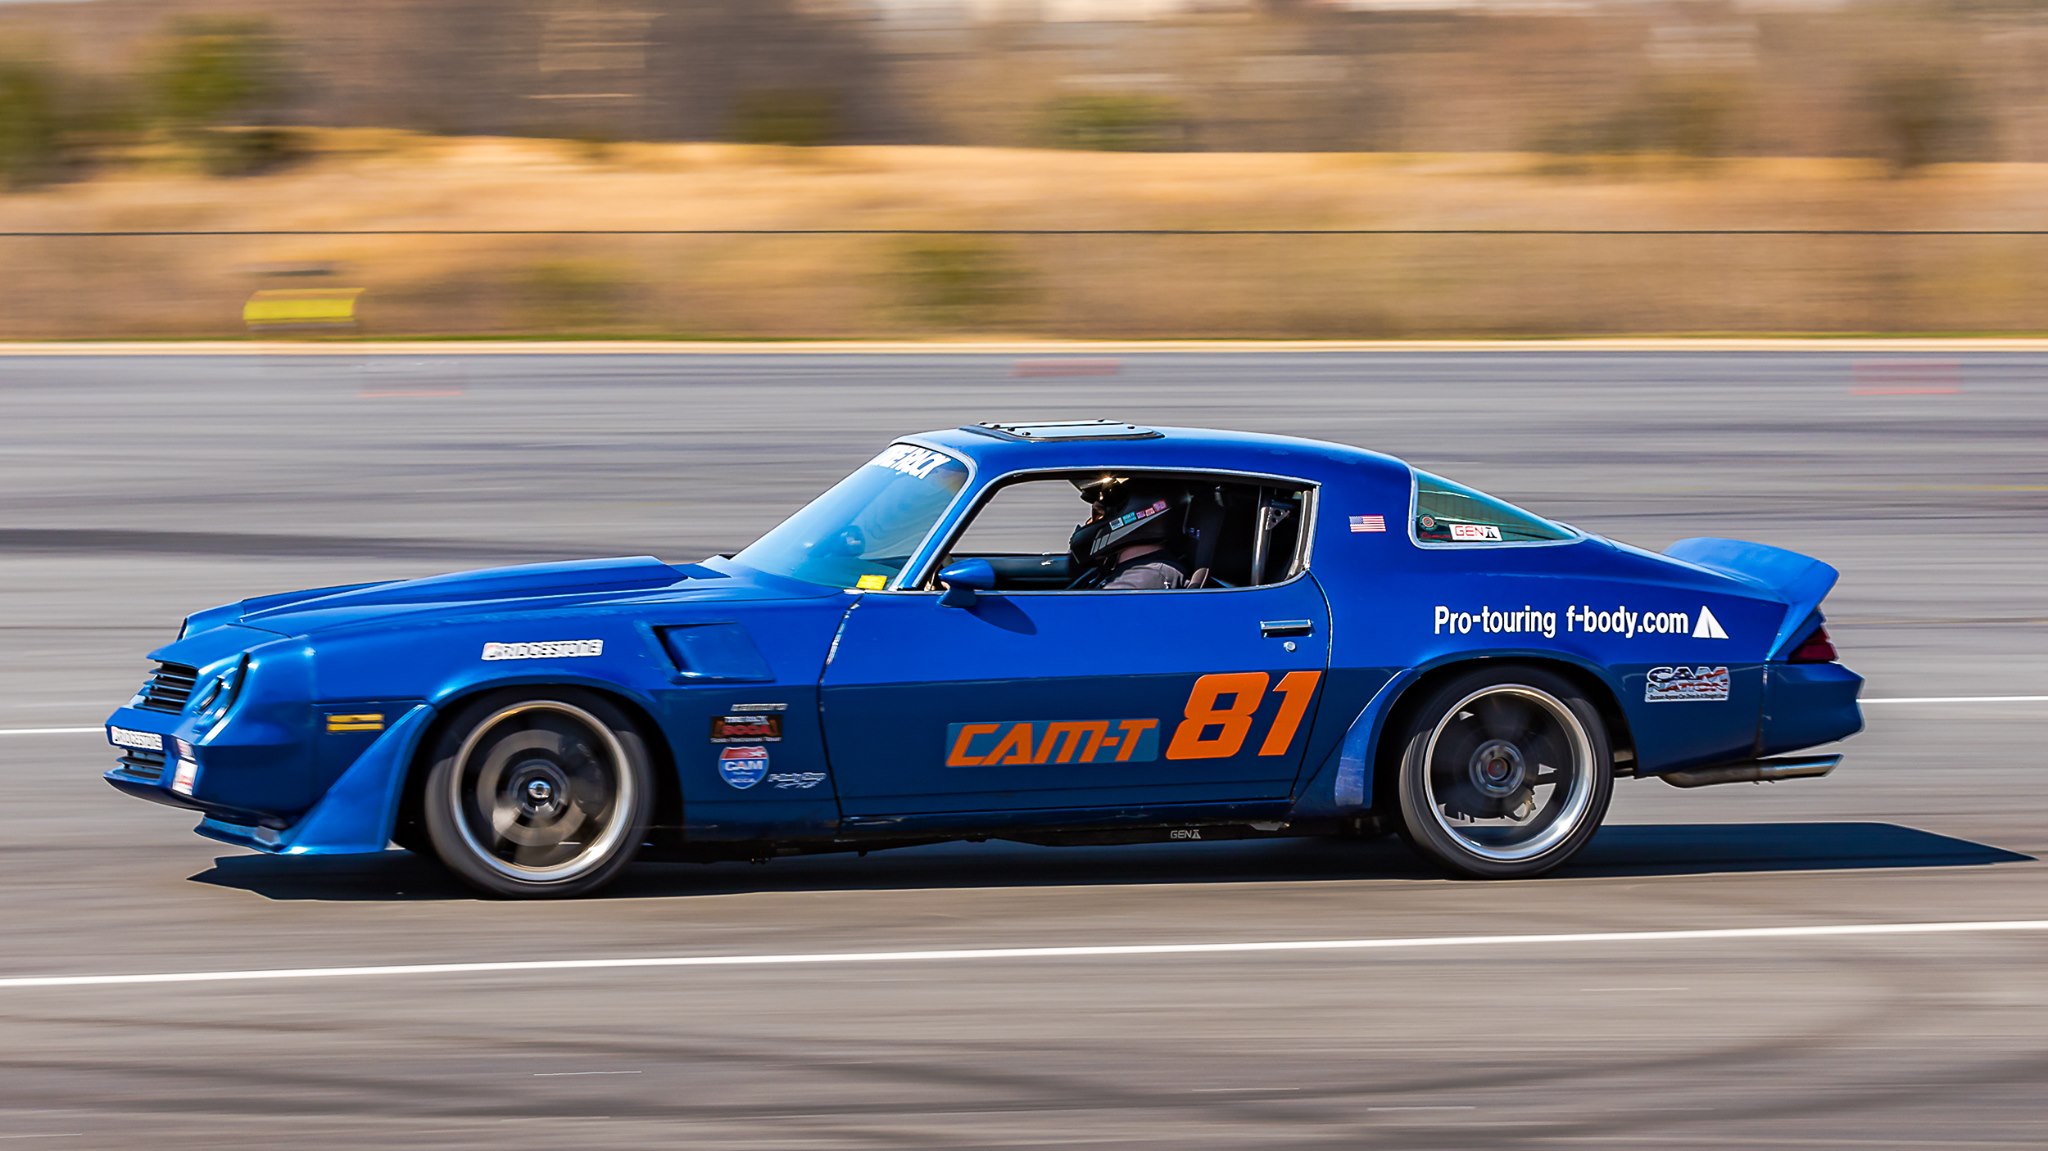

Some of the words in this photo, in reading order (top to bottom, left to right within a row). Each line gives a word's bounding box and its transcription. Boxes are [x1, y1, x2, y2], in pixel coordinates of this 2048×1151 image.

[1434, 605, 1556, 638] Pro-touring
[1566, 605, 1689, 638] f-body.com
[1647, 666, 1729, 684] CAM
[1165, 670, 1322, 760] 81
[946, 718, 1159, 767] CAM-T
[725, 760, 763, 771] CAM
